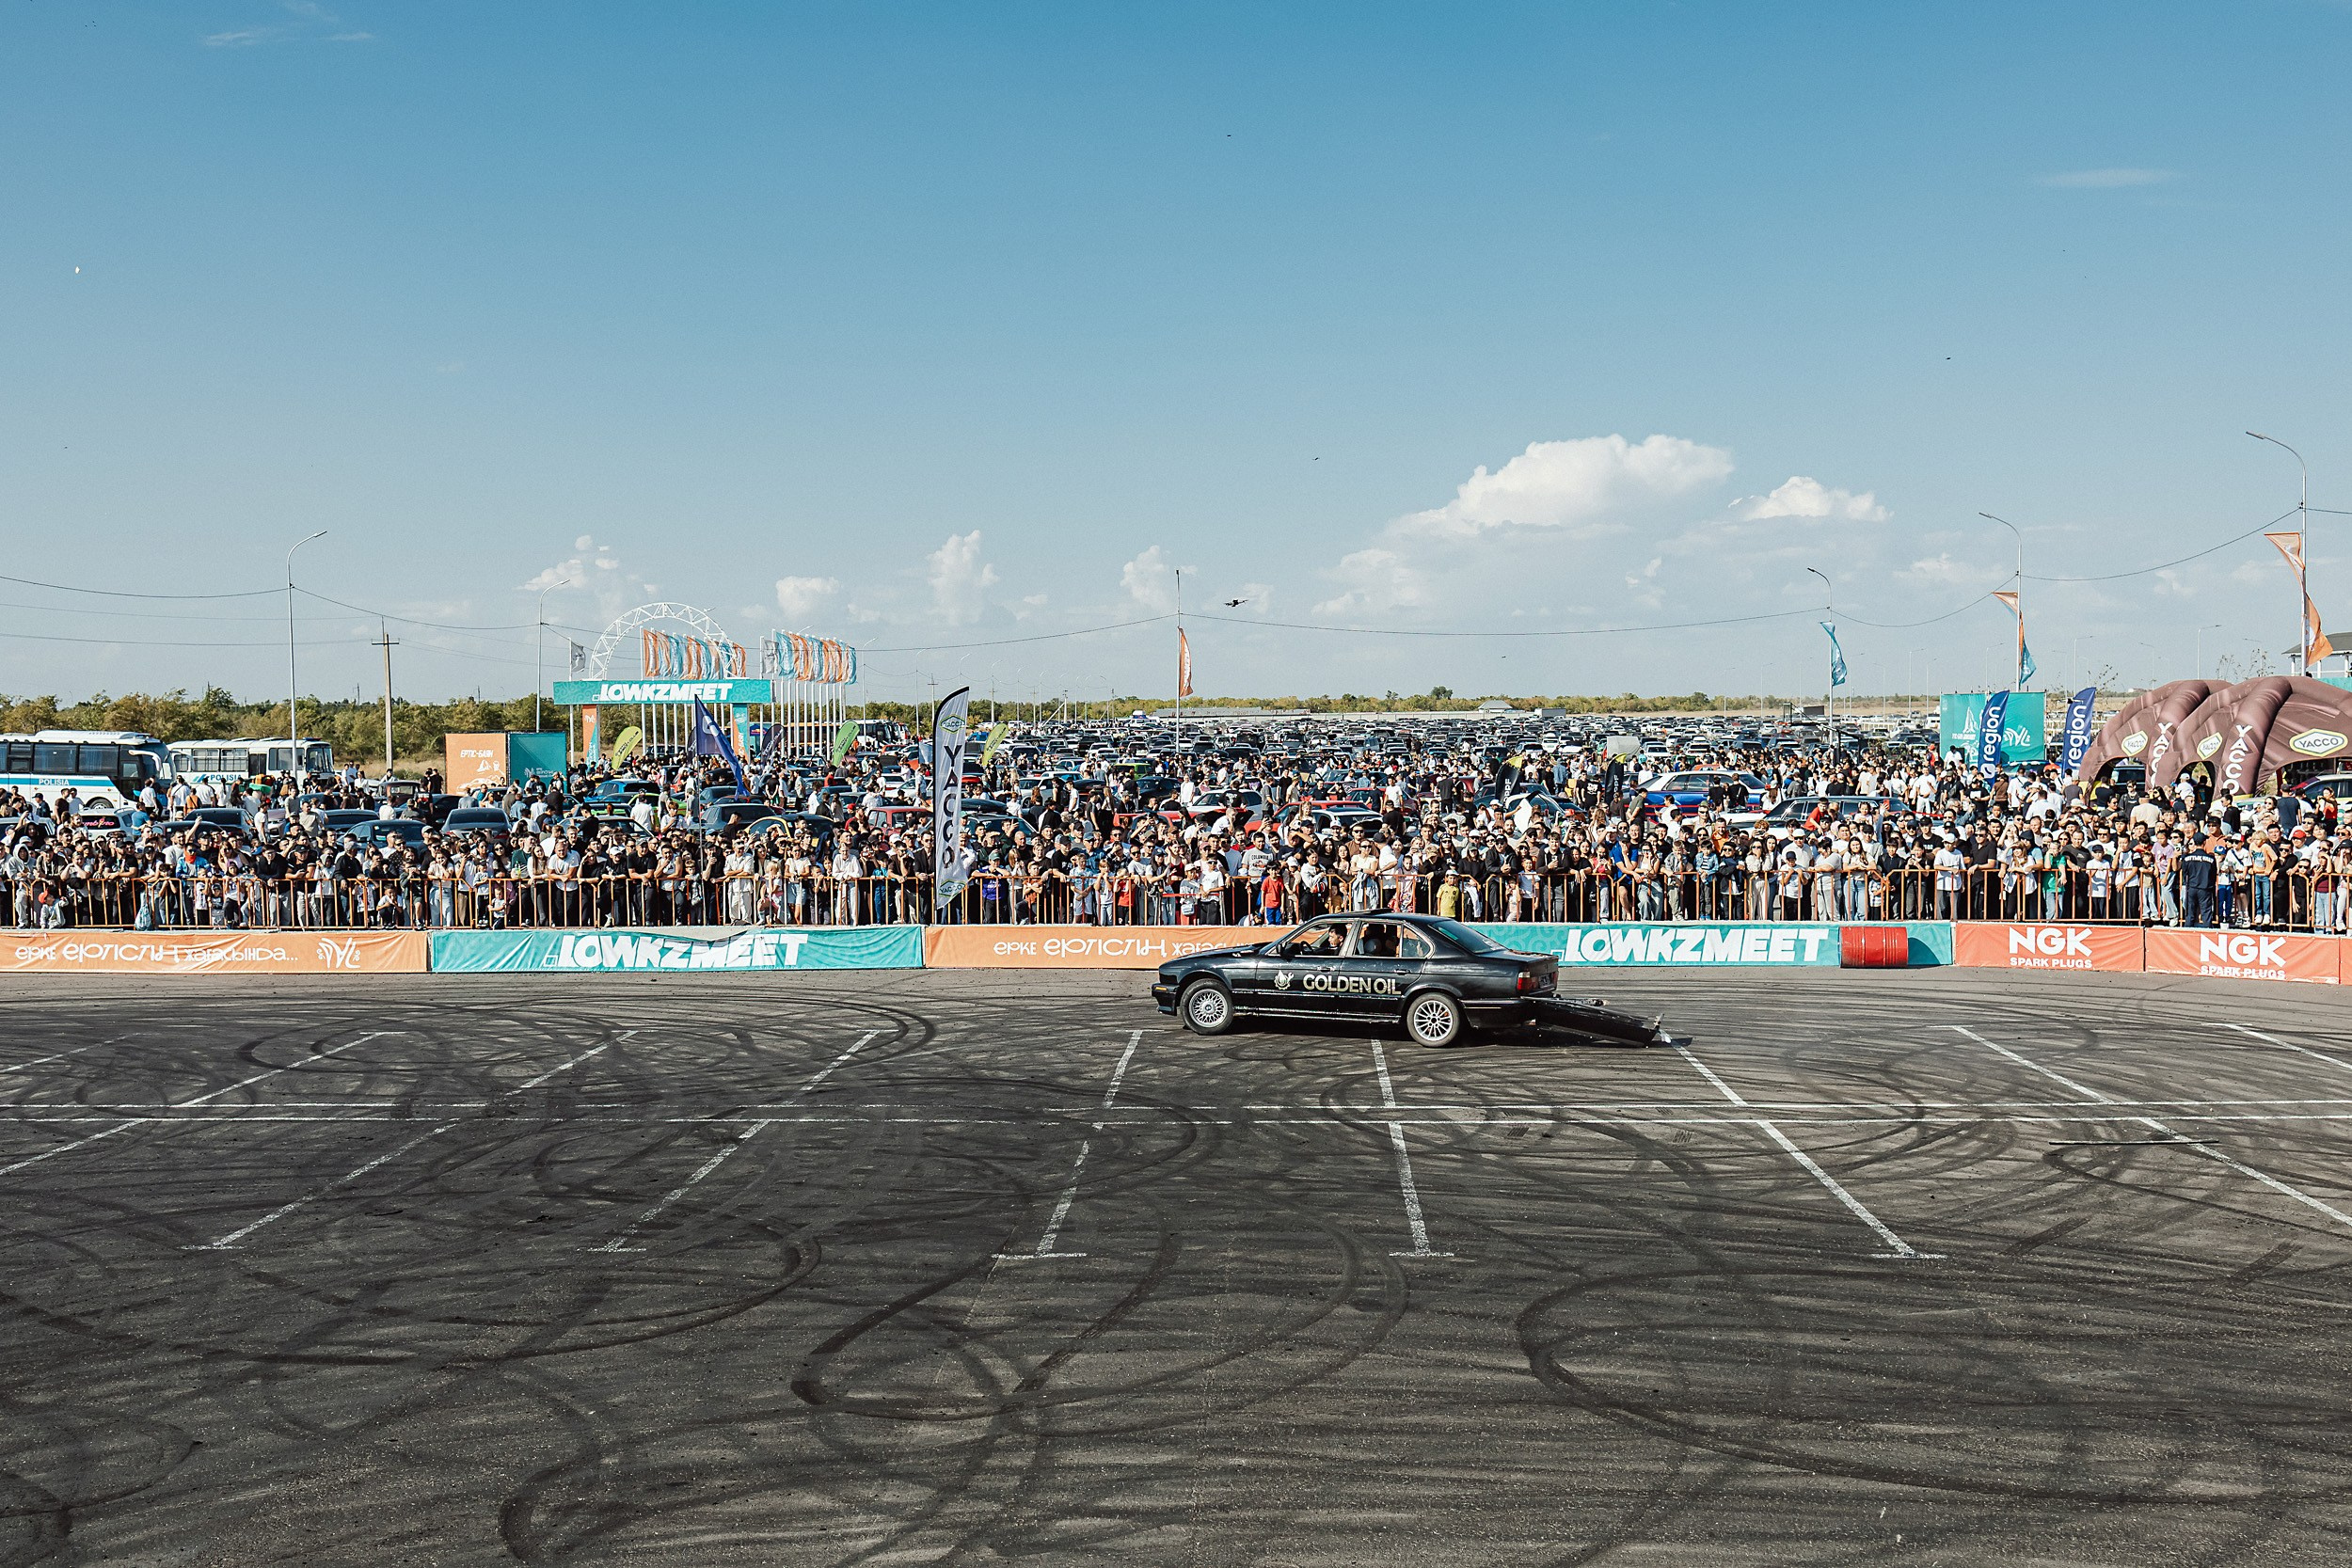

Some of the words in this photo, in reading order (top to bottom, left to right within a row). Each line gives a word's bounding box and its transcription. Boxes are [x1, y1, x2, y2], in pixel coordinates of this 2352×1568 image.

[600, 683, 733, 702] LOWKZMEET
[1982, 705, 2002, 761] region
[2067, 705, 2089, 768] region
[2298, 738, 2339, 748] YACCO
[2223, 724, 2253, 795] YACCO
[39, 778, 71, 786] POLISIA
[943, 744, 963, 869] YACCO
[557, 933, 809, 969] LOWKZMEET
[1562, 928, 1829, 962] LOWKZMEET
[2009, 927, 2093, 958] NGK
[2200, 933, 2287, 968] NGK
[2010, 957, 2049, 967] SPARK
[2051, 958, 2093, 969] PLUGS
[2201, 965, 2242, 977] SPARK
[2243, 968, 2286, 979] PLUGS
[1302, 974, 1372, 993] GOLDEN
[1374, 977, 1402, 995] OIL
